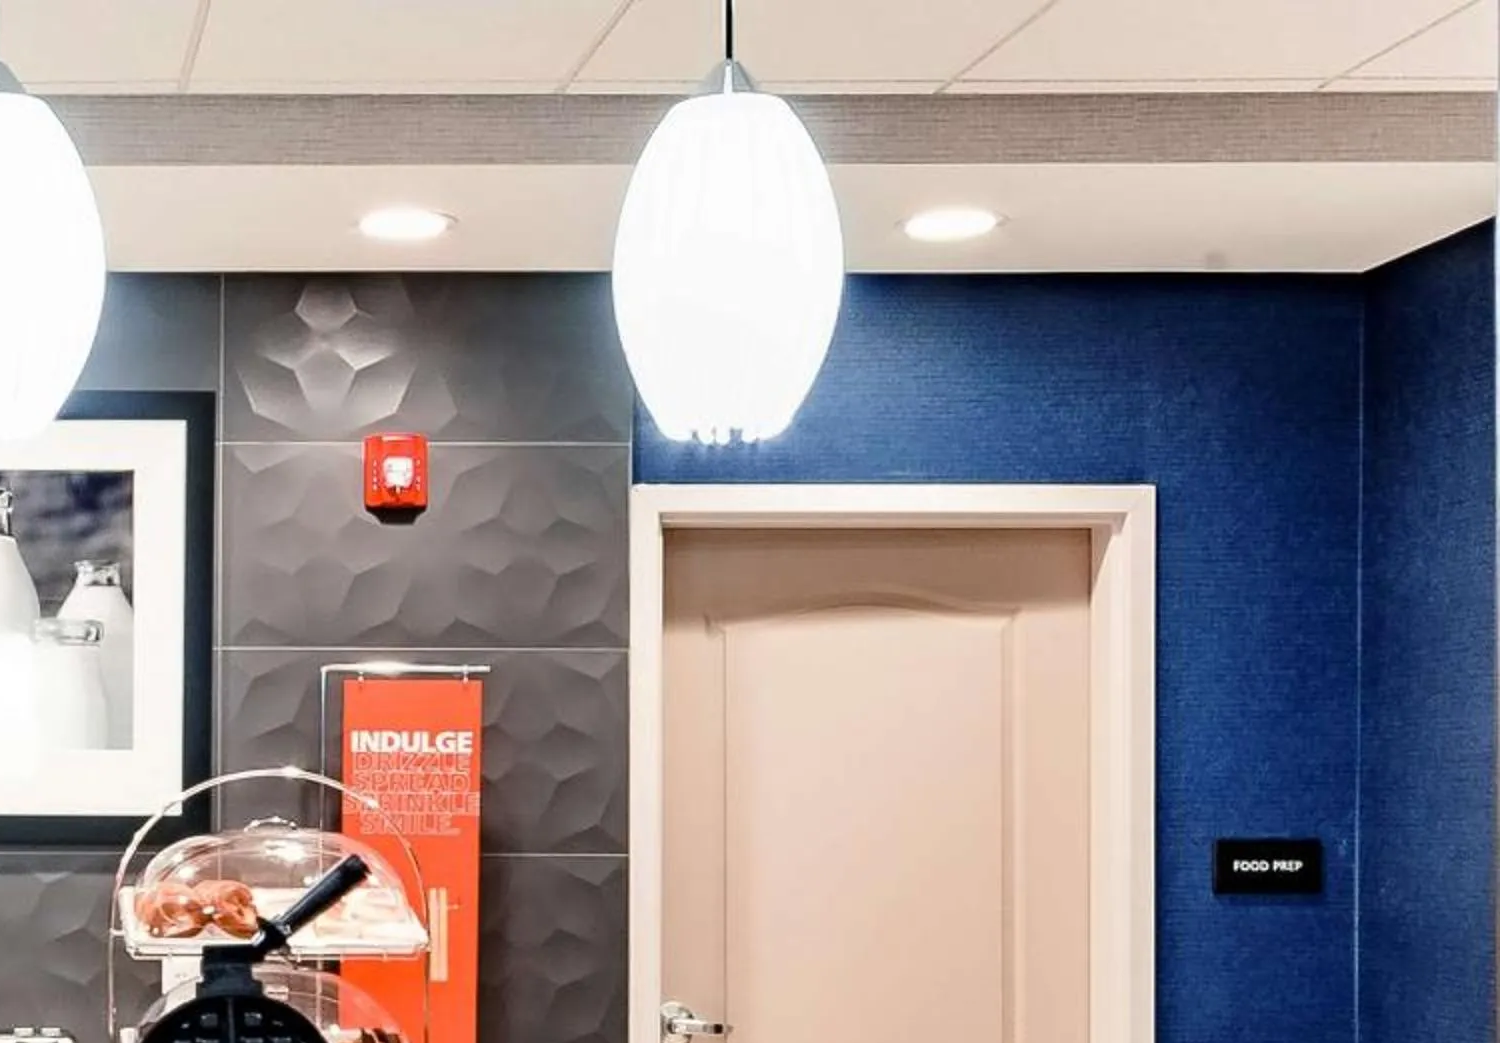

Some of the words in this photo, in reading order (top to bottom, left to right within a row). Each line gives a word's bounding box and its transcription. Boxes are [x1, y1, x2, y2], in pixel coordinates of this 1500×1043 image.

[351, 731, 473, 753] INDULGE
[353, 752, 471, 772] DRIZZLE
[354, 771, 471, 793] SPREAD
[1233, 860, 1269, 872] FOOD
[1273, 860, 1303, 872] PREP
